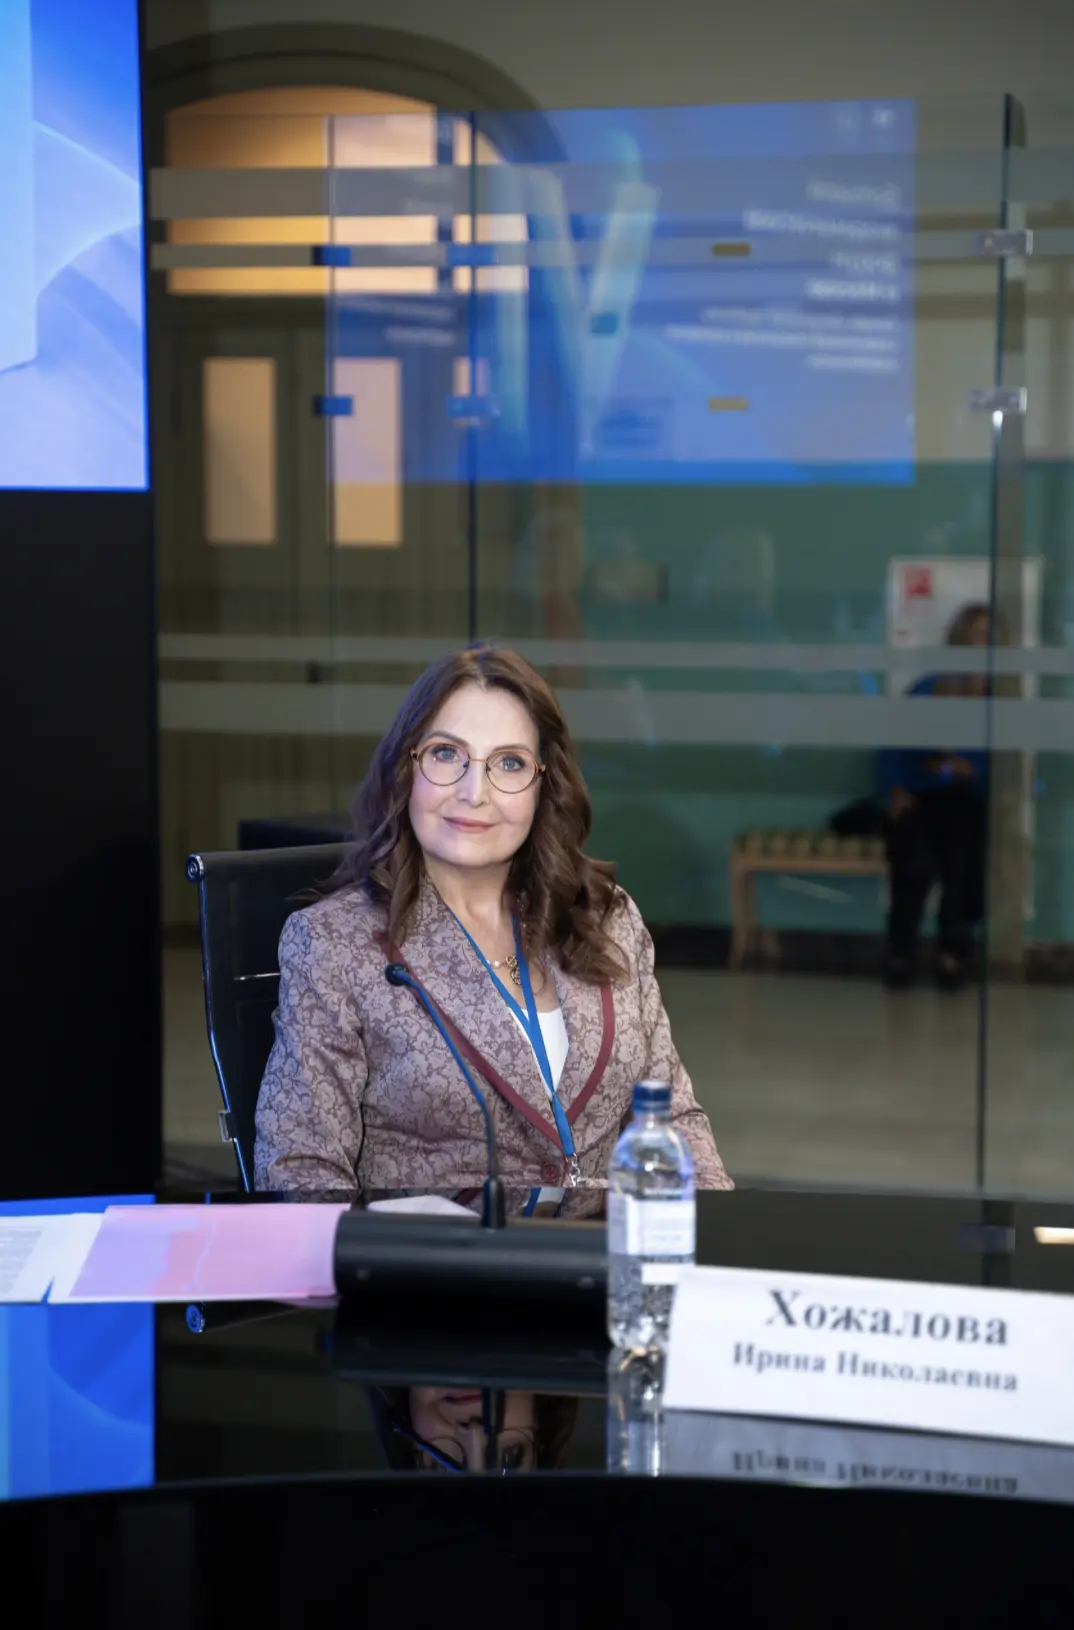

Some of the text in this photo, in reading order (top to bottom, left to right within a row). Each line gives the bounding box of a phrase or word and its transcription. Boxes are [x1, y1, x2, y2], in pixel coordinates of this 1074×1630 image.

[766, 1290, 1008, 1346] Хожалова
[734, 1341, 1018, 1392] Ирина Николаевна
